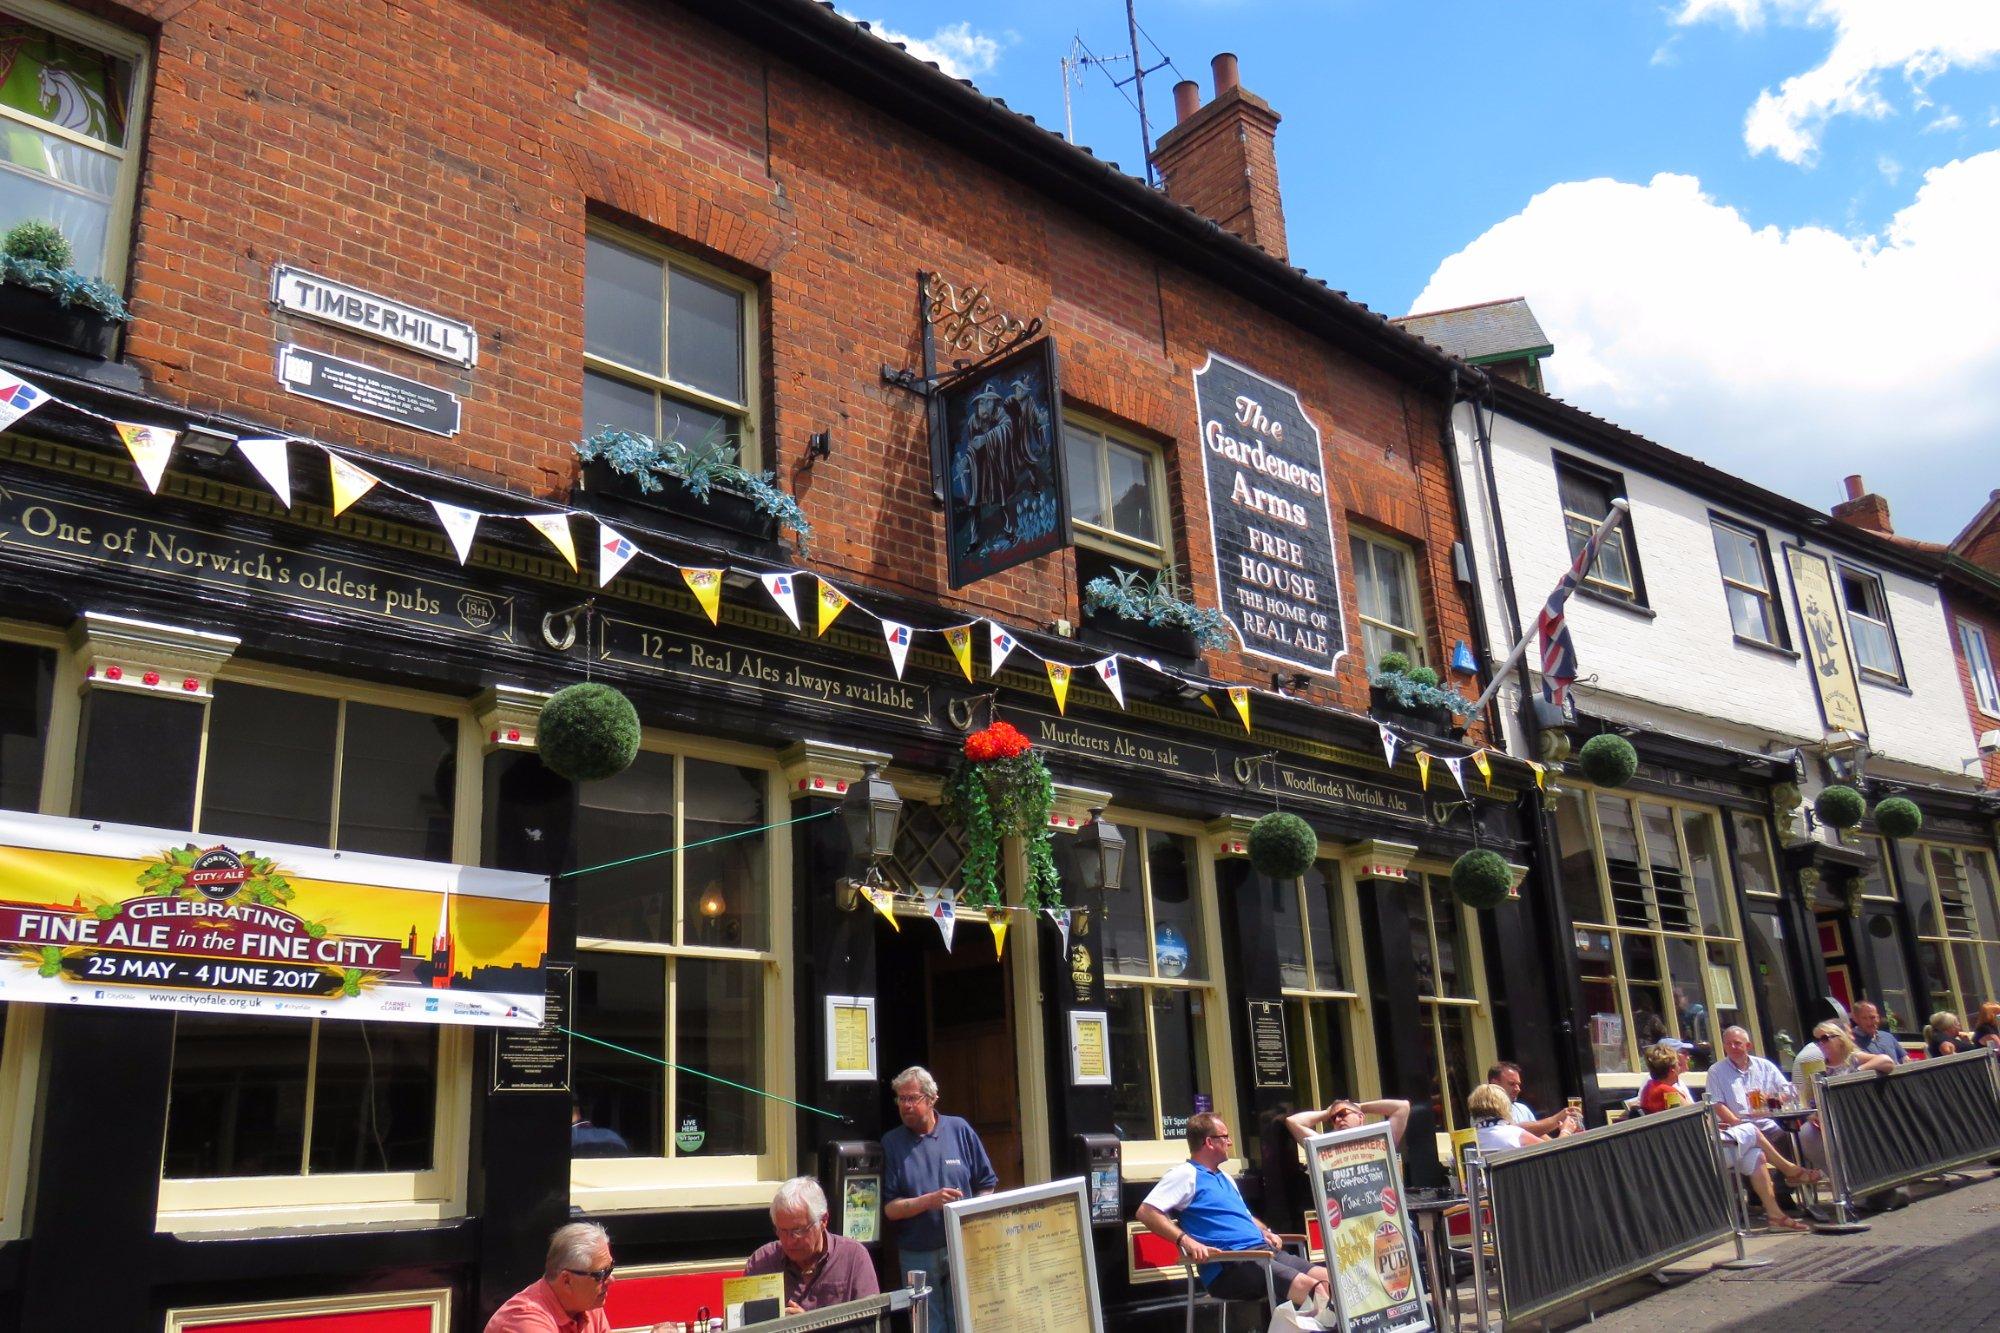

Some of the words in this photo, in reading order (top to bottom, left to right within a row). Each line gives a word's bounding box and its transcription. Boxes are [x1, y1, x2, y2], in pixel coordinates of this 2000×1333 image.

[294, 280, 457, 354] TIMBERHILL
[380, 384, 400, 394] century
[419, 402, 438, 412] century
[1234, 396, 1284, 442] The
[1206, 420, 1322, 496] Gardeners
[1231, 471, 1308, 528] Arms
[22, 506, 92, 544] One
[102, 528, 137, 554] of
[146, 531, 291, 584] Norwich's
[300, 566, 376, 602] oldest
[384, 588, 440, 614] pubs
[1247, 526, 1304, 567] FREE
[1238, 554, 1318, 603] HOUSE
[466, 602, 488, 618] 18th
[1236, 587, 1264, 610] THE
[1266, 597, 1308, 625] HOME
[1310, 612, 1328, 631] OF
[1242, 611, 1292, 644] REAL
[1294, 628, 1328, 656] ALE
[640, 633, 663, 660] 12
[690, 643, 732, 674] Real
[738, 653, 780, 684] Ales
[785, 666, 841, 700] always
[846, 683, 914, 712] available
[1040, 720, 1110, 752] Murderers
[1114, 736, 1136, 757] Ale
[1139, 746, 1154, 760] on
[1157, 748, 1180, 766] sale
[1282, 770, 1344, 798] Woodforde's
[1346, 784, 1384, 807] Norfolk
[1388, 793, 1407, 812] Ales
[193, 872, 217, 882] CITY
[224, 870, 244, 880] ALE
[202, 856, 238, 870] NORWICH
[128, 902, 296, 934] CELEBRATING
[18, 914, 100, 944] FINE
[105, 922, 171, 950] ALE
[176, 930, 196, 948] in
[202, 928, 236, 950] the
[241, 932, 310, 960] FINE
[316, 940, 383, 966] CITY
[88, 957, 116, 976] 25
[121, 959, 176, 980] MAY
[194, 965, 209, 982] 4
[212, 966, 268, 986] JUNE
[272, 970, 320, 989] 2017
[1074, 972, 1090, 980] GOLD
[150, 992, 262, 1008] www.cityofale.org.uk
[1336, 1138, 1386, 1154] MURDERERS
[1332, 1166, 1355, 1180] MUST
[1378, 1250, 1408, 1274] PUB
[1362, 1313, 1380, 1325] Sport
